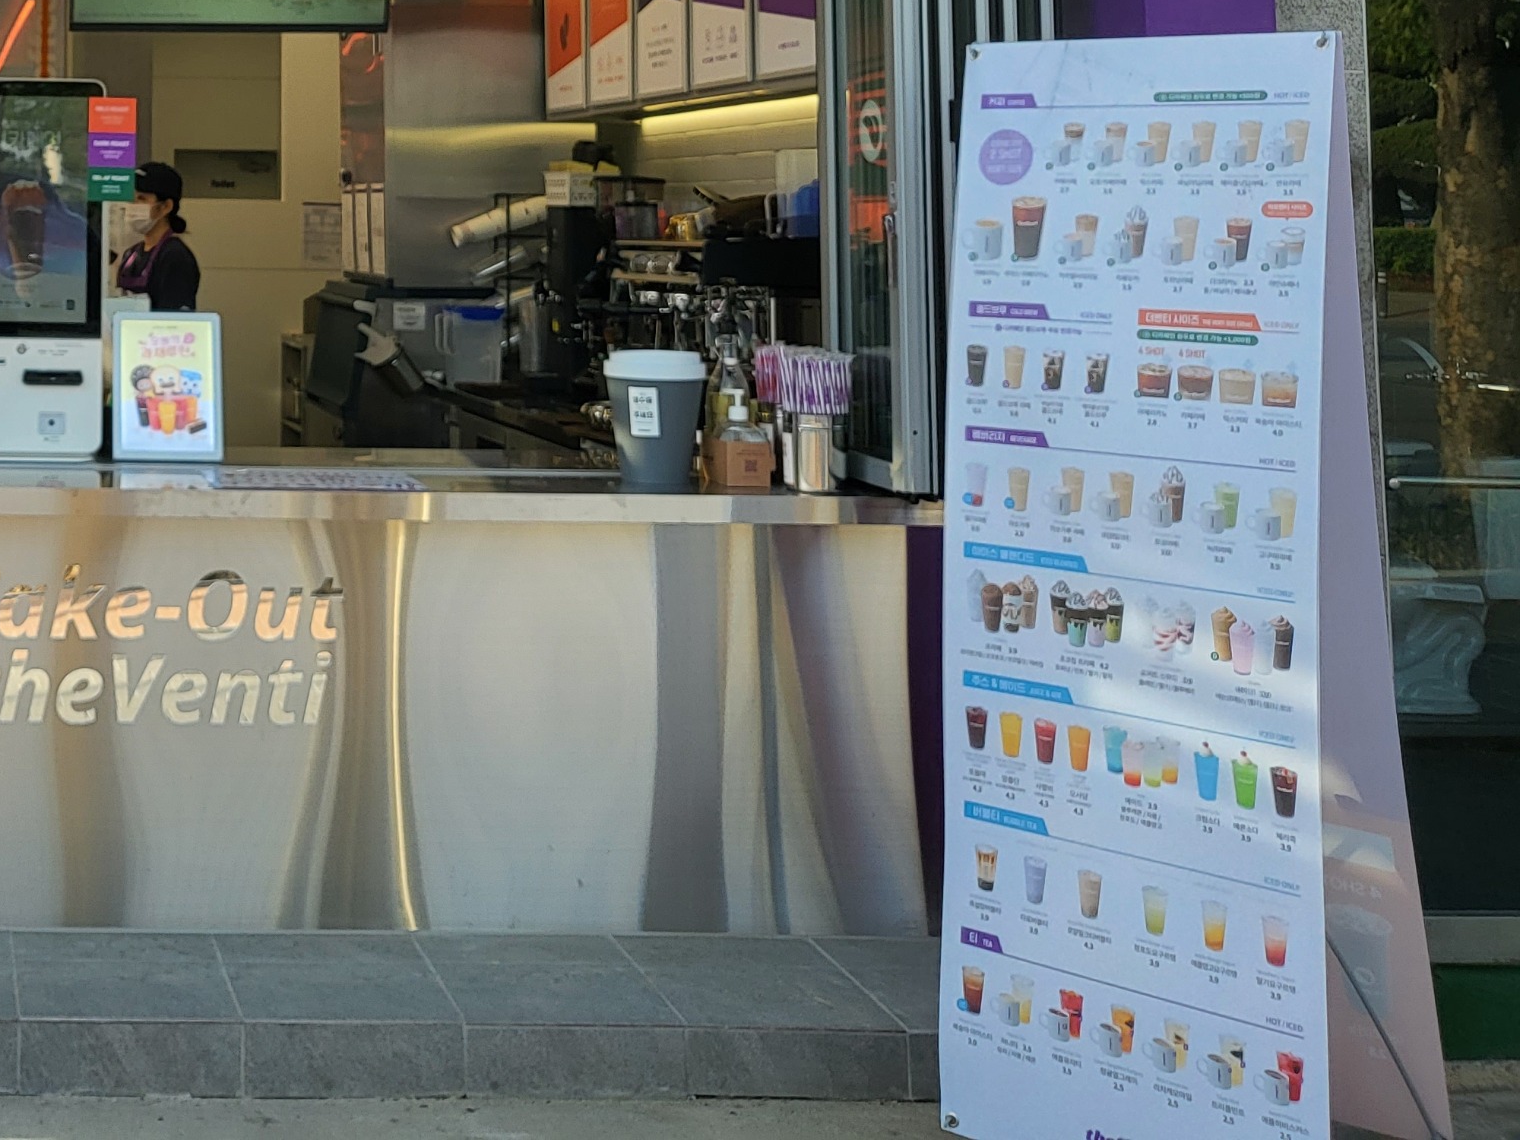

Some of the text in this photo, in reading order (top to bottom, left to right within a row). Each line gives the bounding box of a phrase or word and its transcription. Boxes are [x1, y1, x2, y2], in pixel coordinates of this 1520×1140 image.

[1145, 311, 1172, 324] 더벤티
[1173, 313, 1200, 326] 사이즈
[1144, 347, 1166, 357] SHOT
[1185, 349, 1207, 359] SHOT
[1202, 825, 1213, 835] 3.9
[1240, 834, 1252, 843] 3.9
[1280, 843, 1292, 853] 3.9
[982, 938, 995, 952] TEA
[1149, 958, 1160, 969] 3.9
[1208, 975, 1220, 985] 3.9
[1269, 991, 1282, 1001] 3.9
[1265, 1015, 1282, 1028] HOT
[1286, 1021, 1304, 1033] ICED
[1113, 1081, 1125, 1093] 2.5
[1167, 1097, 1180, 1109] 2.5
[1211, 1099, 1247, 1118] 트리플민트
[1222, 1114, 1235, 1126] 2.5
